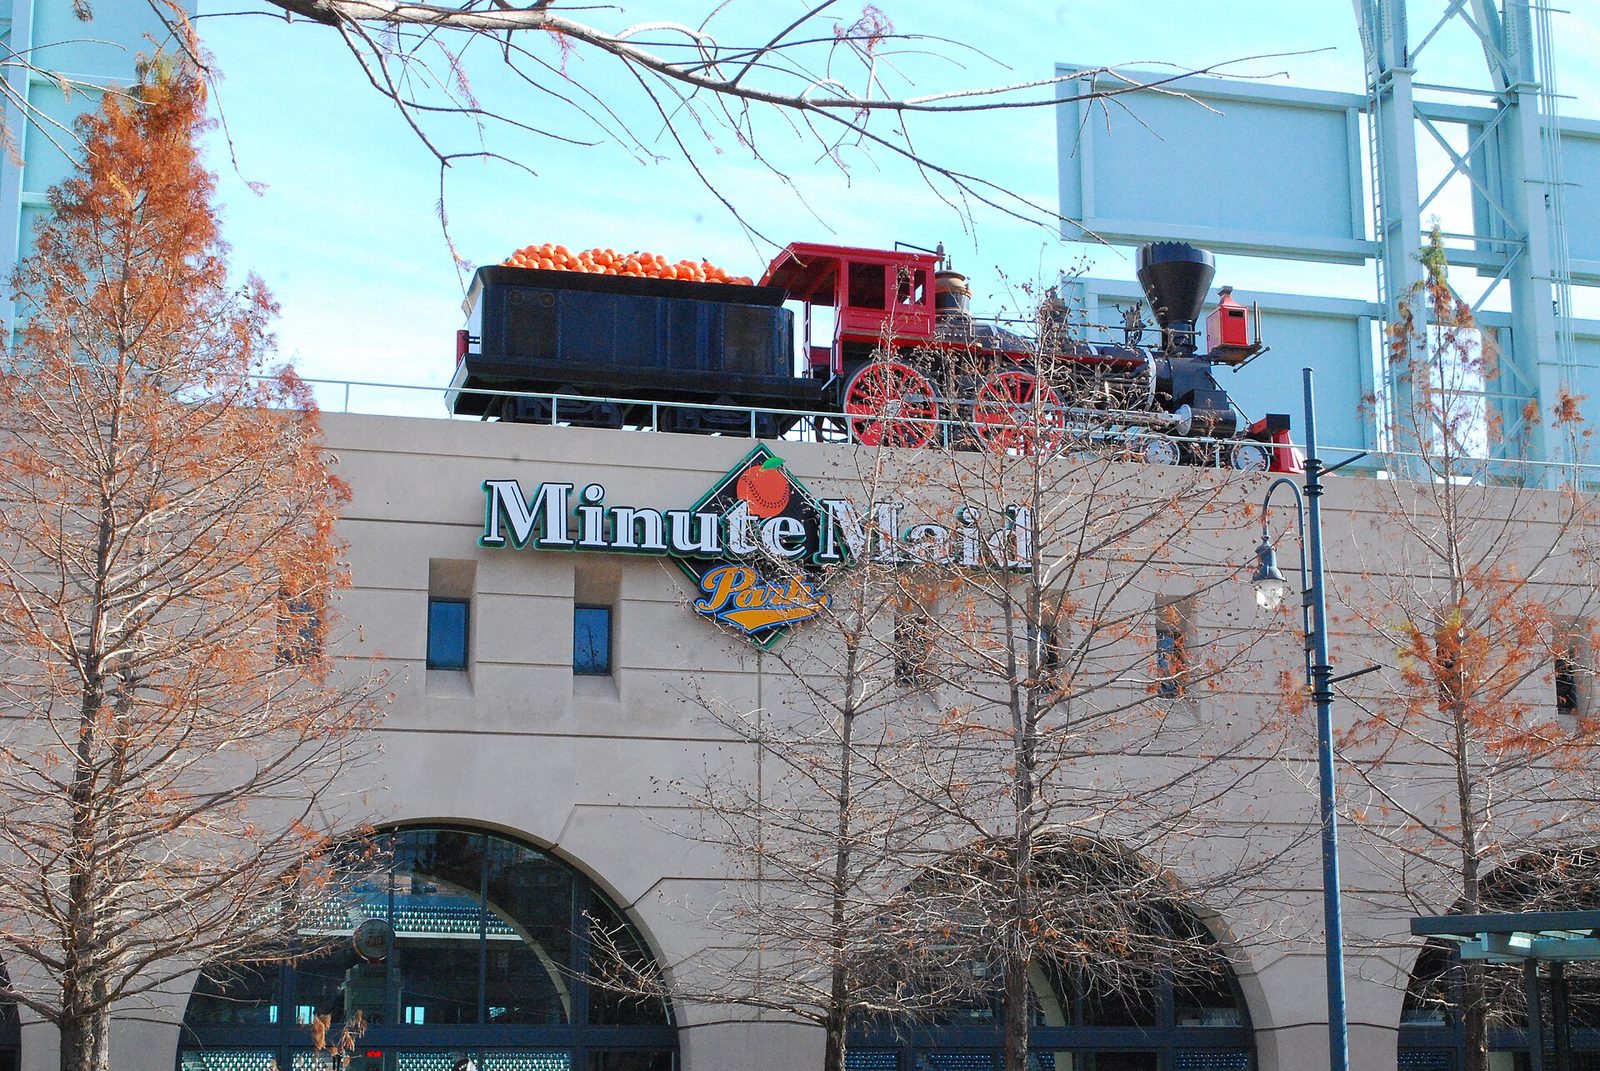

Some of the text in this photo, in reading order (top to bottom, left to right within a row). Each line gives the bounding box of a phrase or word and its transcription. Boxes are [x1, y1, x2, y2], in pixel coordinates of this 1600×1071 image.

[480, 479, 1034, 571] Minute Maid
[694, 563, 831, 618] Park
